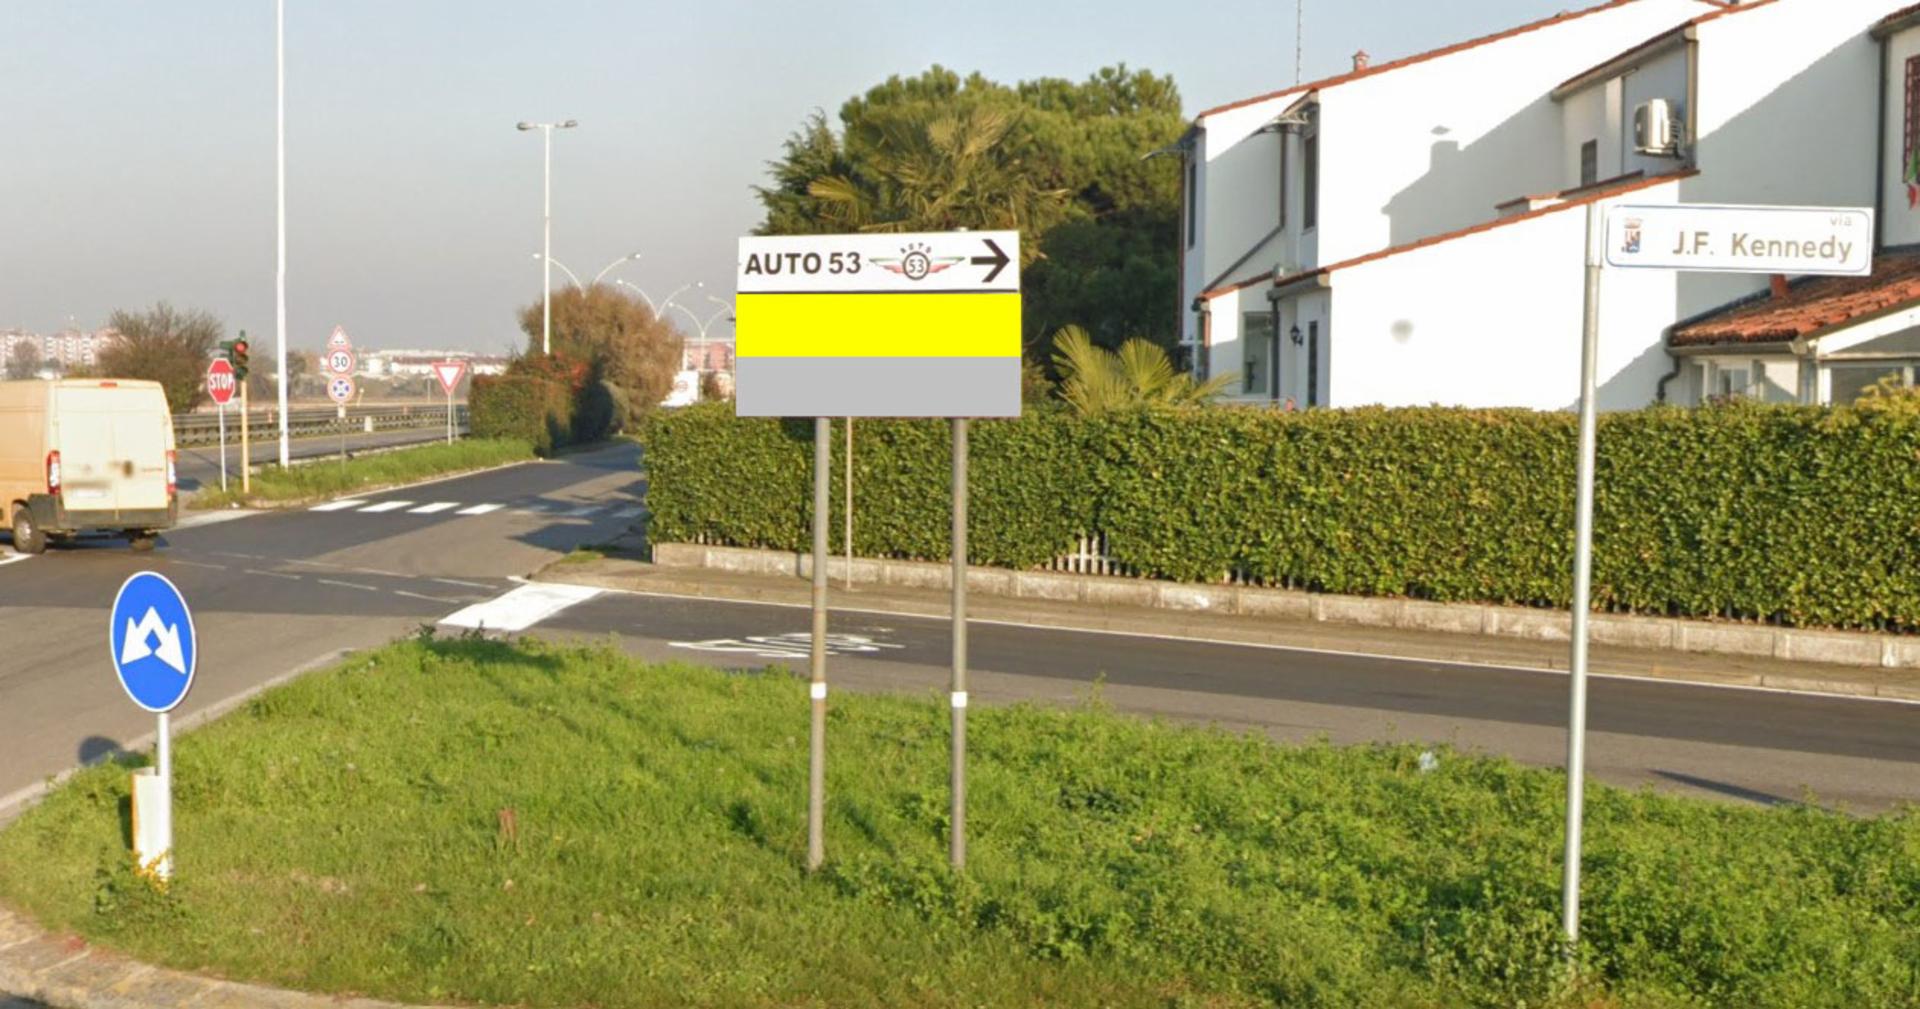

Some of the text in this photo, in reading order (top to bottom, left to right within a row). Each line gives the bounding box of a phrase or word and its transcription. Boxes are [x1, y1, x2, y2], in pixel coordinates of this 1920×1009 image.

[1829, 214, 1853, 227] via
[1672, 230, 1853, 264] J.F. Kennedy
[744, 251, 862, 275] AUTO 53
[908, 258, 925, 274] 53
[333, 356, 348, 368] 30
[209, 372, 235, 390] STOP
